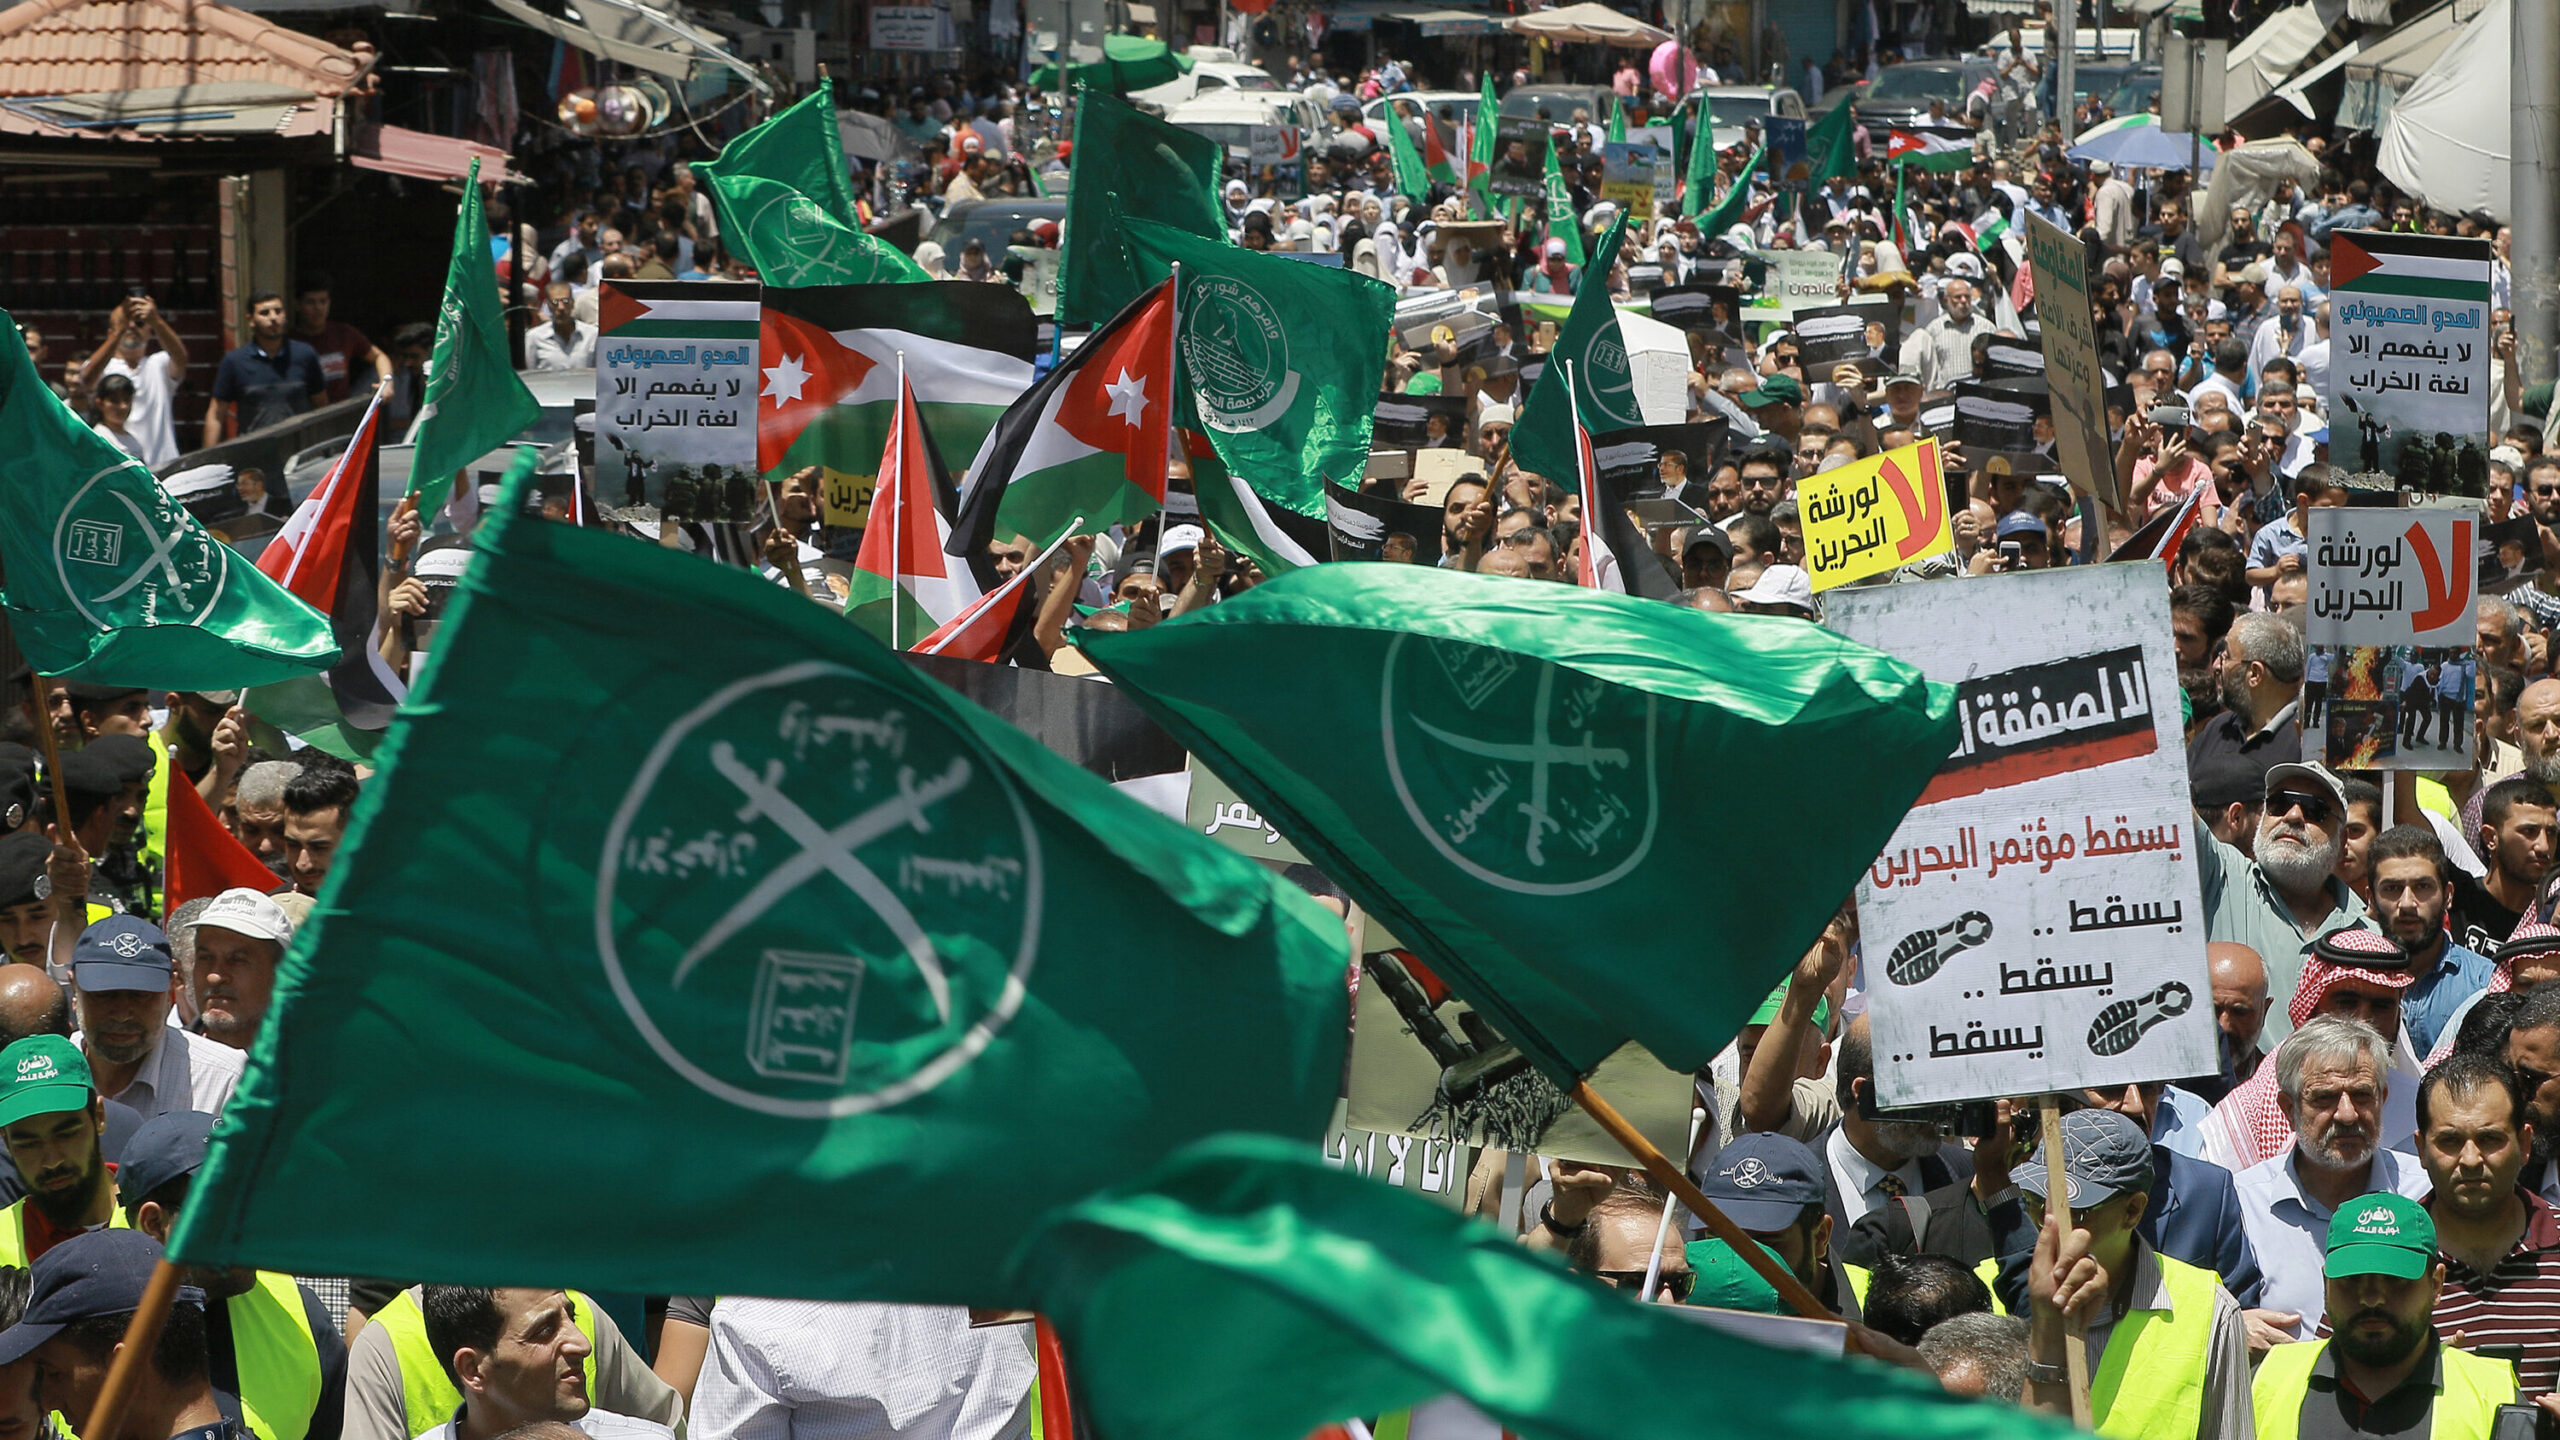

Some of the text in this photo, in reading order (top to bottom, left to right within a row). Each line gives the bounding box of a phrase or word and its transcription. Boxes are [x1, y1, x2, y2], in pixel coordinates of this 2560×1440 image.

[2031, 223, 2085, 296] المقاومة
[2340, 300, 2479, 332] العدو الصهيوني
[606, 344, 749, 370] العدو الصهيوني
[2349, 335, 2471, 365] لا يفهم إلا
[615, 377, 740, 401] لا يفهم إلا
[2350, 369, 2469, 394] لغة الخراب
[616, 408, 737, 432] لغة الخراب
[1808, 475, 1879, 523] لورشة
[1878, 442, 1942, 562] لا
[1813, 516, 1888, 573] البحرين
[2317, 530, 2401, 578] لورشة
[2404, 520, 2471, 633] لا
[2314, 581, 2402, 622] البحرين
[1977, 667, 2116, 747] لصفقة
[2120, 660, 2149, 719] لا
[1871, 815, 2180, 888] يسقط مؤتمر البحرين
[2069, 895, 2182, 934] يسقط
[2000, 957, 2114, 997] يسقط
[1929, 1020, 2043, 1060] يسقط
